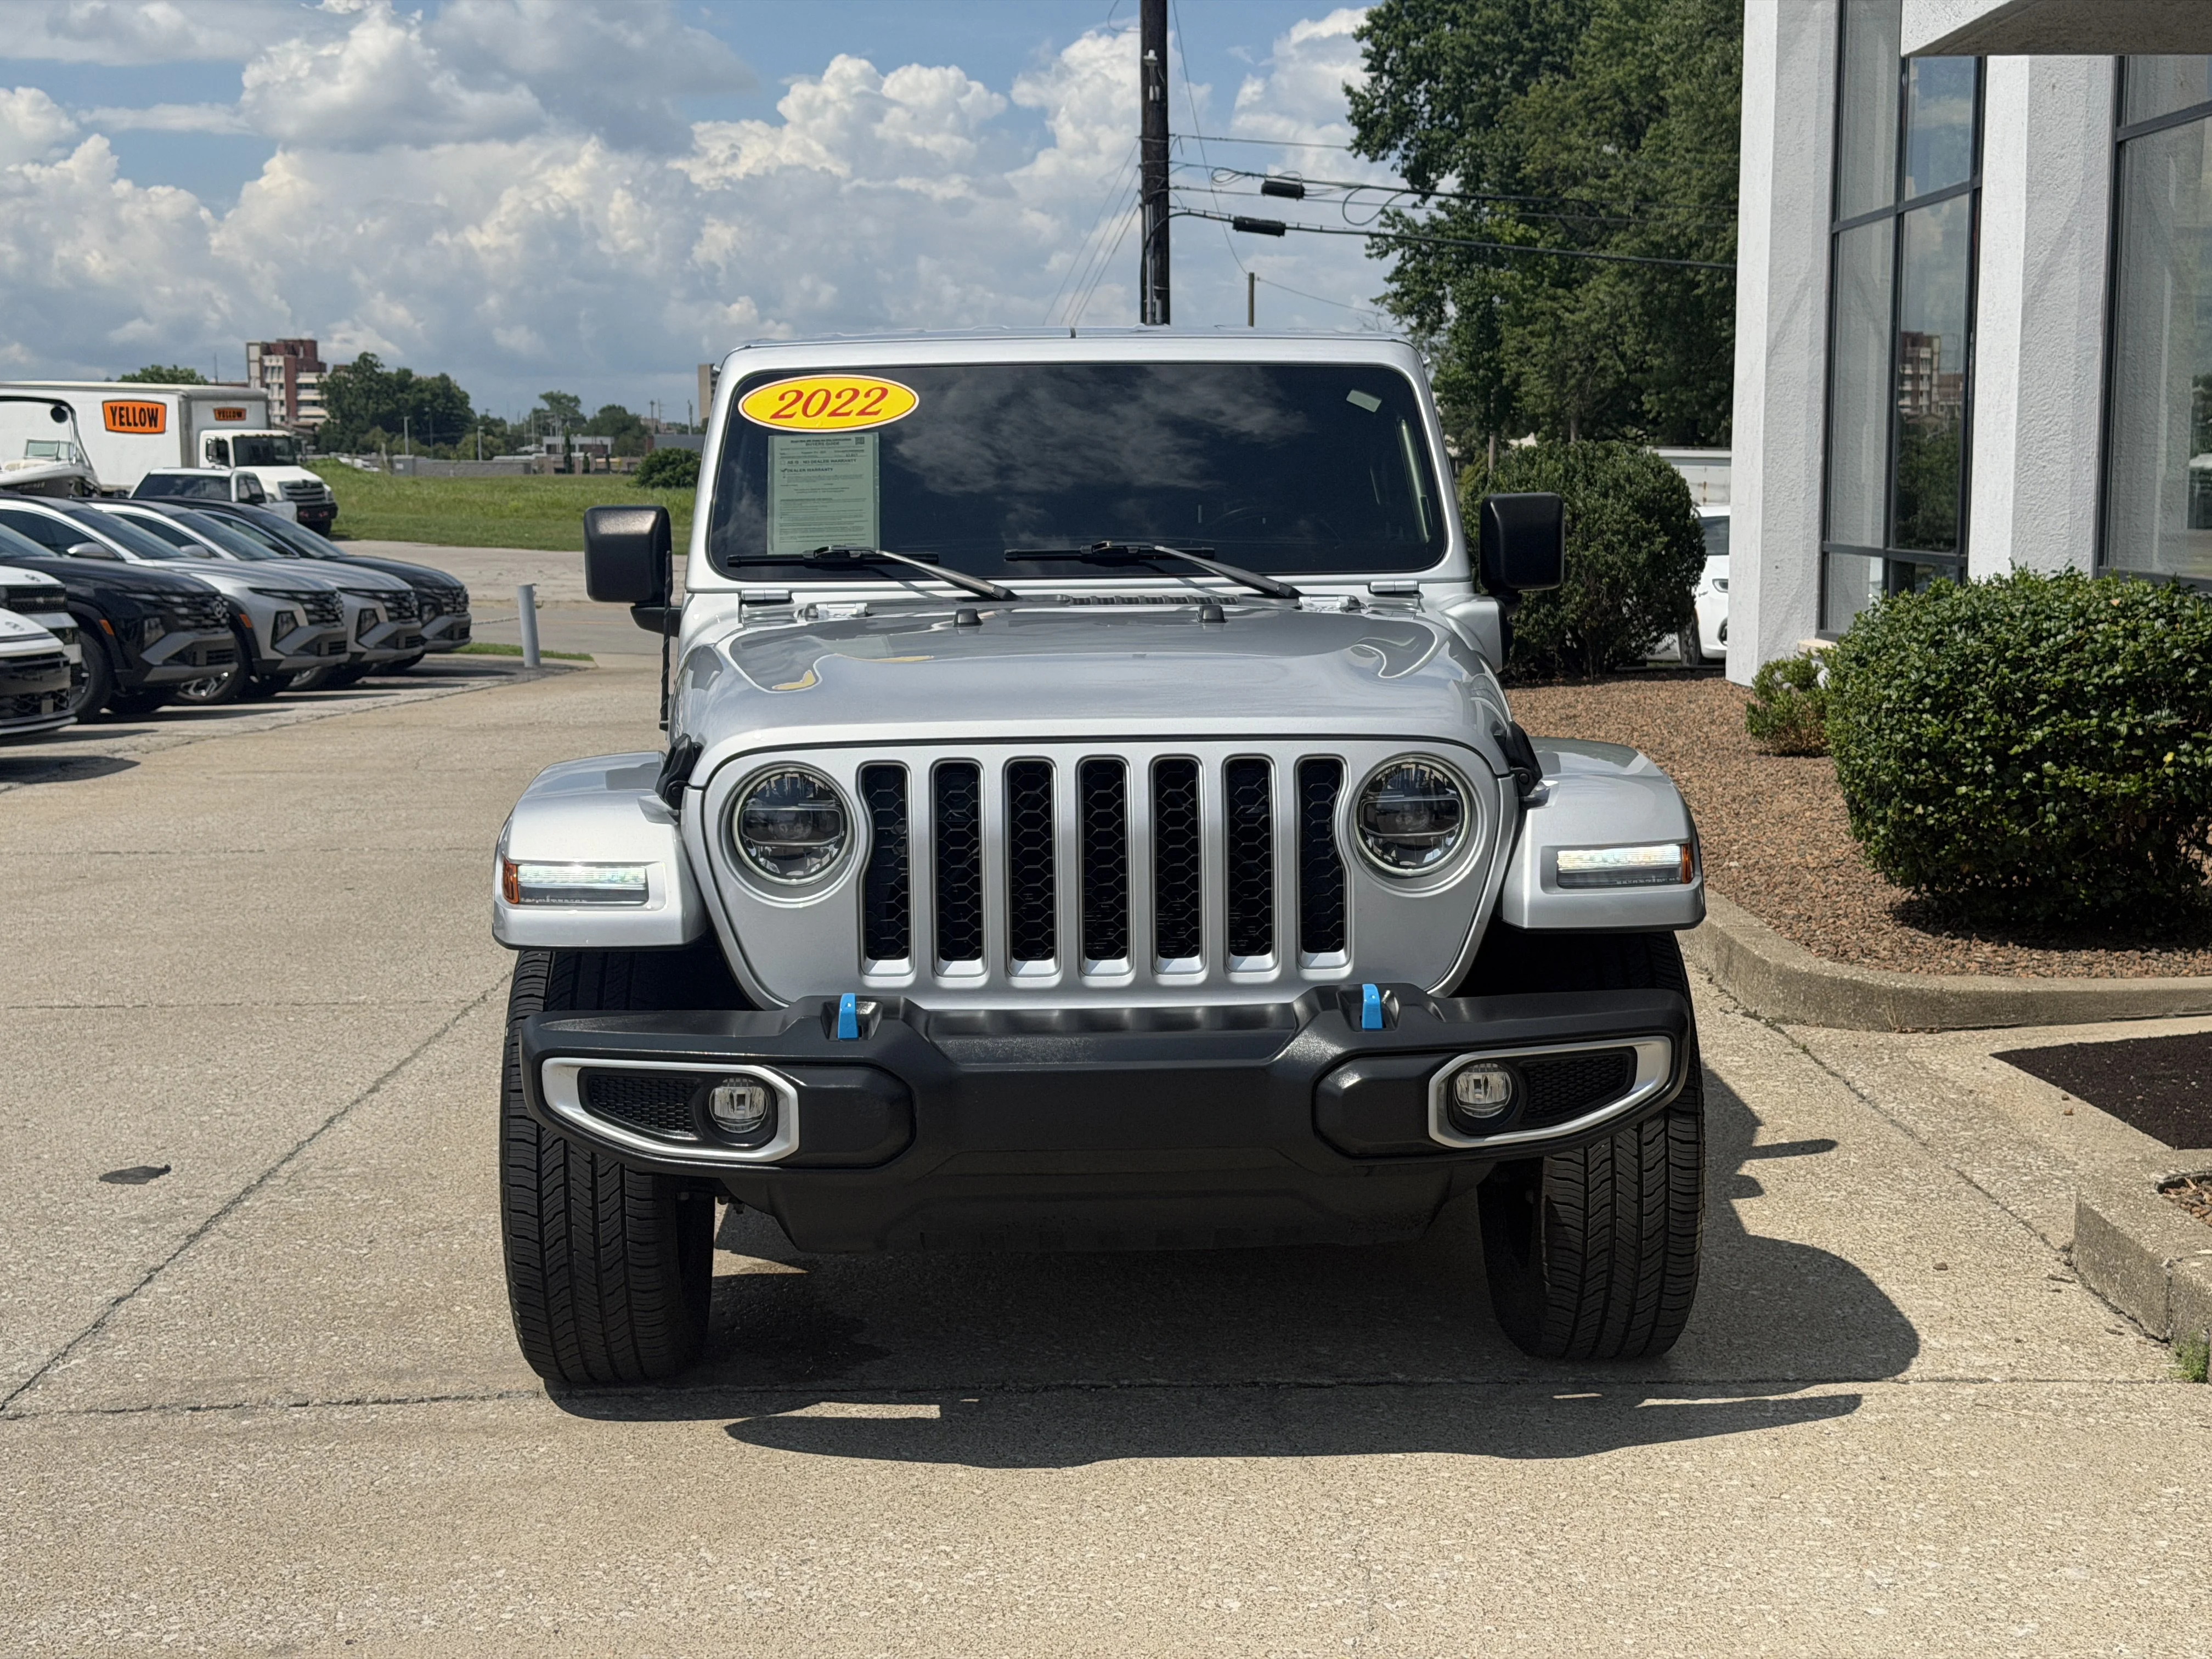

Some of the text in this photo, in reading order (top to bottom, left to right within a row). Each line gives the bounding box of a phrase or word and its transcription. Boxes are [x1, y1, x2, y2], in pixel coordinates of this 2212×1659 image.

[769, 386, 889, 419] 2022
[109, 405, 159, 428] YELLOW
[218, 410, 242, 419] YELLOW
